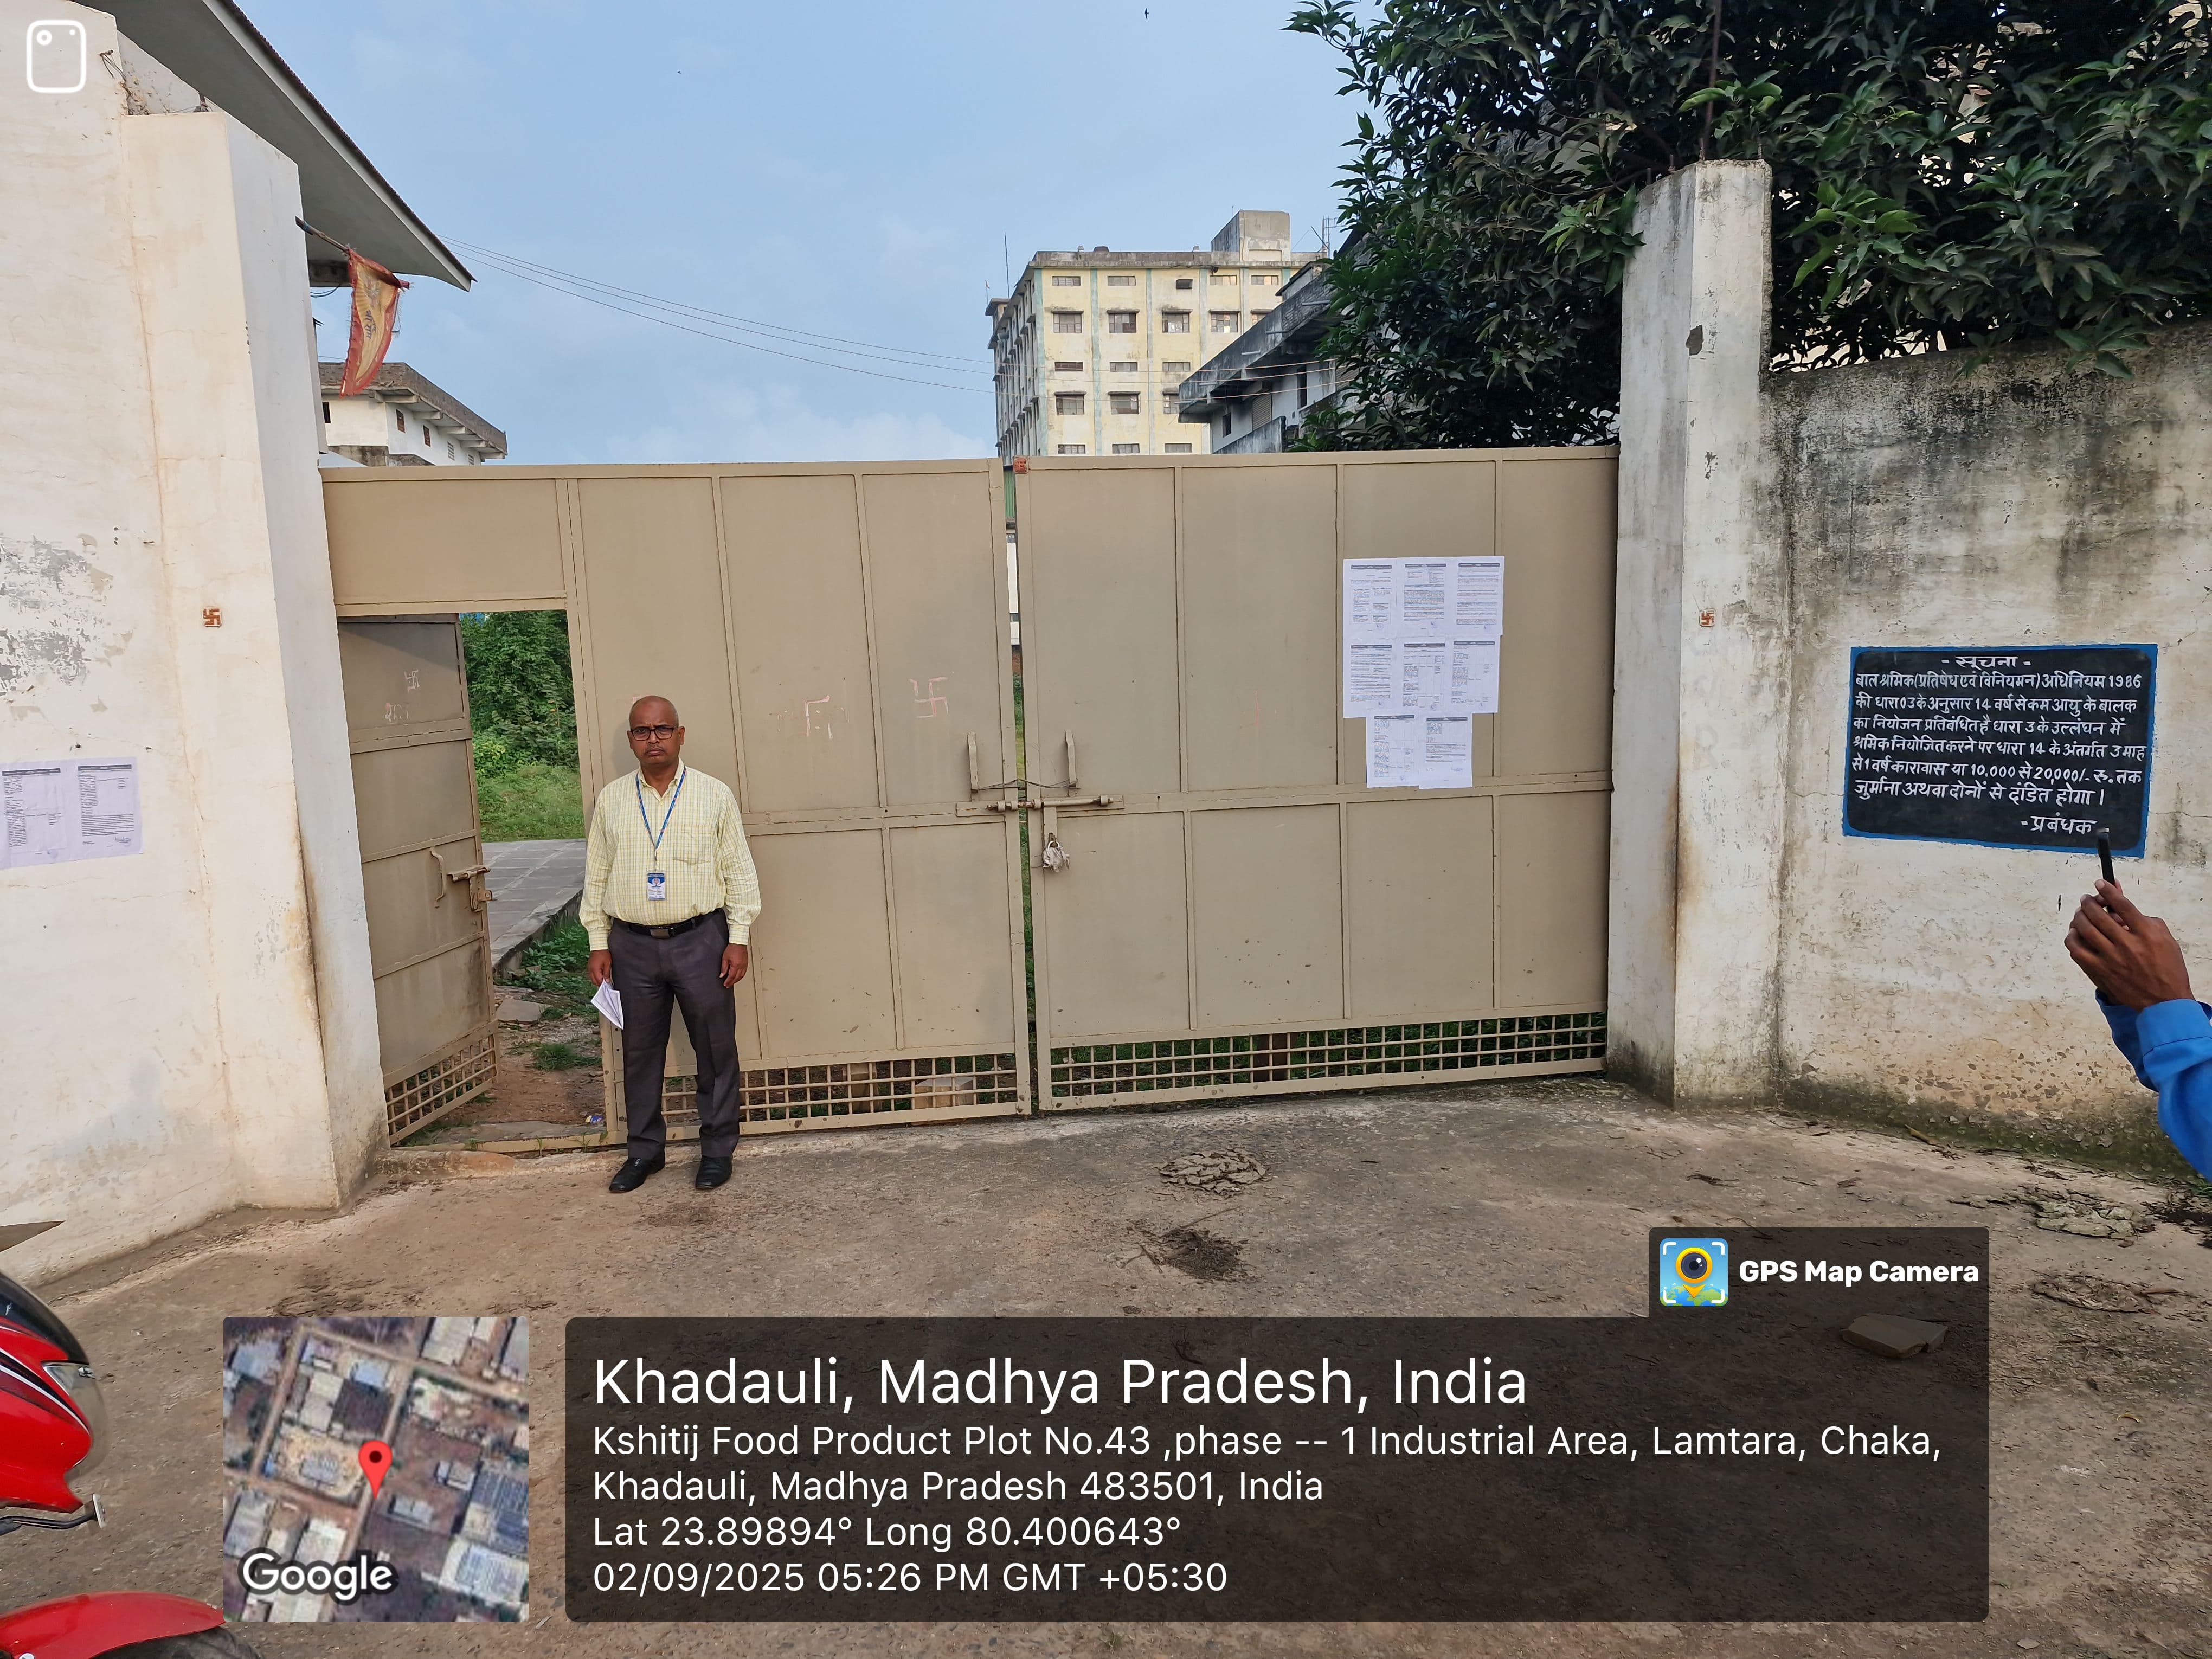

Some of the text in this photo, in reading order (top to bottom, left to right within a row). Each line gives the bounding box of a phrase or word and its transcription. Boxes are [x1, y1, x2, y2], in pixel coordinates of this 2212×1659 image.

[1954, 655, 2018, 671] सूचना
[1856, 673, 1880, 688] बाल
[1959, 671, 1979, 688] एवं
[2109, 674, 2143, 689] 1986
[1855, 691, 1873, 709] की
[1875, 697, 1900, 709] धारा
[1916, 693, 1927, 710] के
[1927, 697, 1974, 714] अनुसार
[1976, 698, 1992, 710] 14
[1993, 693, 2015, 711] वर्ष
[2014, 694, 2029, 711] से
[2027, 698, 2052, 712] कम
[2051, 698, 2082, 717] आयु
[2082, 695, 2097, 712] के
[2098, 699, 2138, 713] बालक
[1853, 717, 1872, 729] का
[1872, 713, 1924, 731] नियोजन
[1924, 715, 1982, 732] प्रतिबंधित
[1979, 713, 1992, 735] है
[1993, 720, 2024, 734] धारा
[2037, 715, 2050, 734] के
[2110, 717, 2127, 735] में
[1853, 733, 1890, 751] श्रमिक
[1891, 734, 1947, 753] नियोजित
[1945, 735, 1978, 753] करने
[1978, 741, 1996, 754] पर
[1996, 742, 2027, 756] धारा
[2030, 742, 2046, 755] 14
[2048, 738, 2061, 756] के
[2062, 740, 2108, 758] अंतर्गत
[2121, 745, 2147, 761] माह
[1851, 752, 1864, 771] से
[1871, 755, 1893, 773] वर्ष
[1891, 760, 1951, 776] कारावास
[1951, 763, 1970, 776] या
[2017, 760, 2034, 779] से
[2115, 769, 2143, 784] तक
[1854, 776, 1903, 800] जुर्माना
[1902, 782, 1950, 798] अथवा
[1949, 780, 1988, 800] दोनों
[1989, 782, 2007, 800] से
[2008, 782, 2053, 805] दंडित
[2055, 782, 2097, 807] होगा
